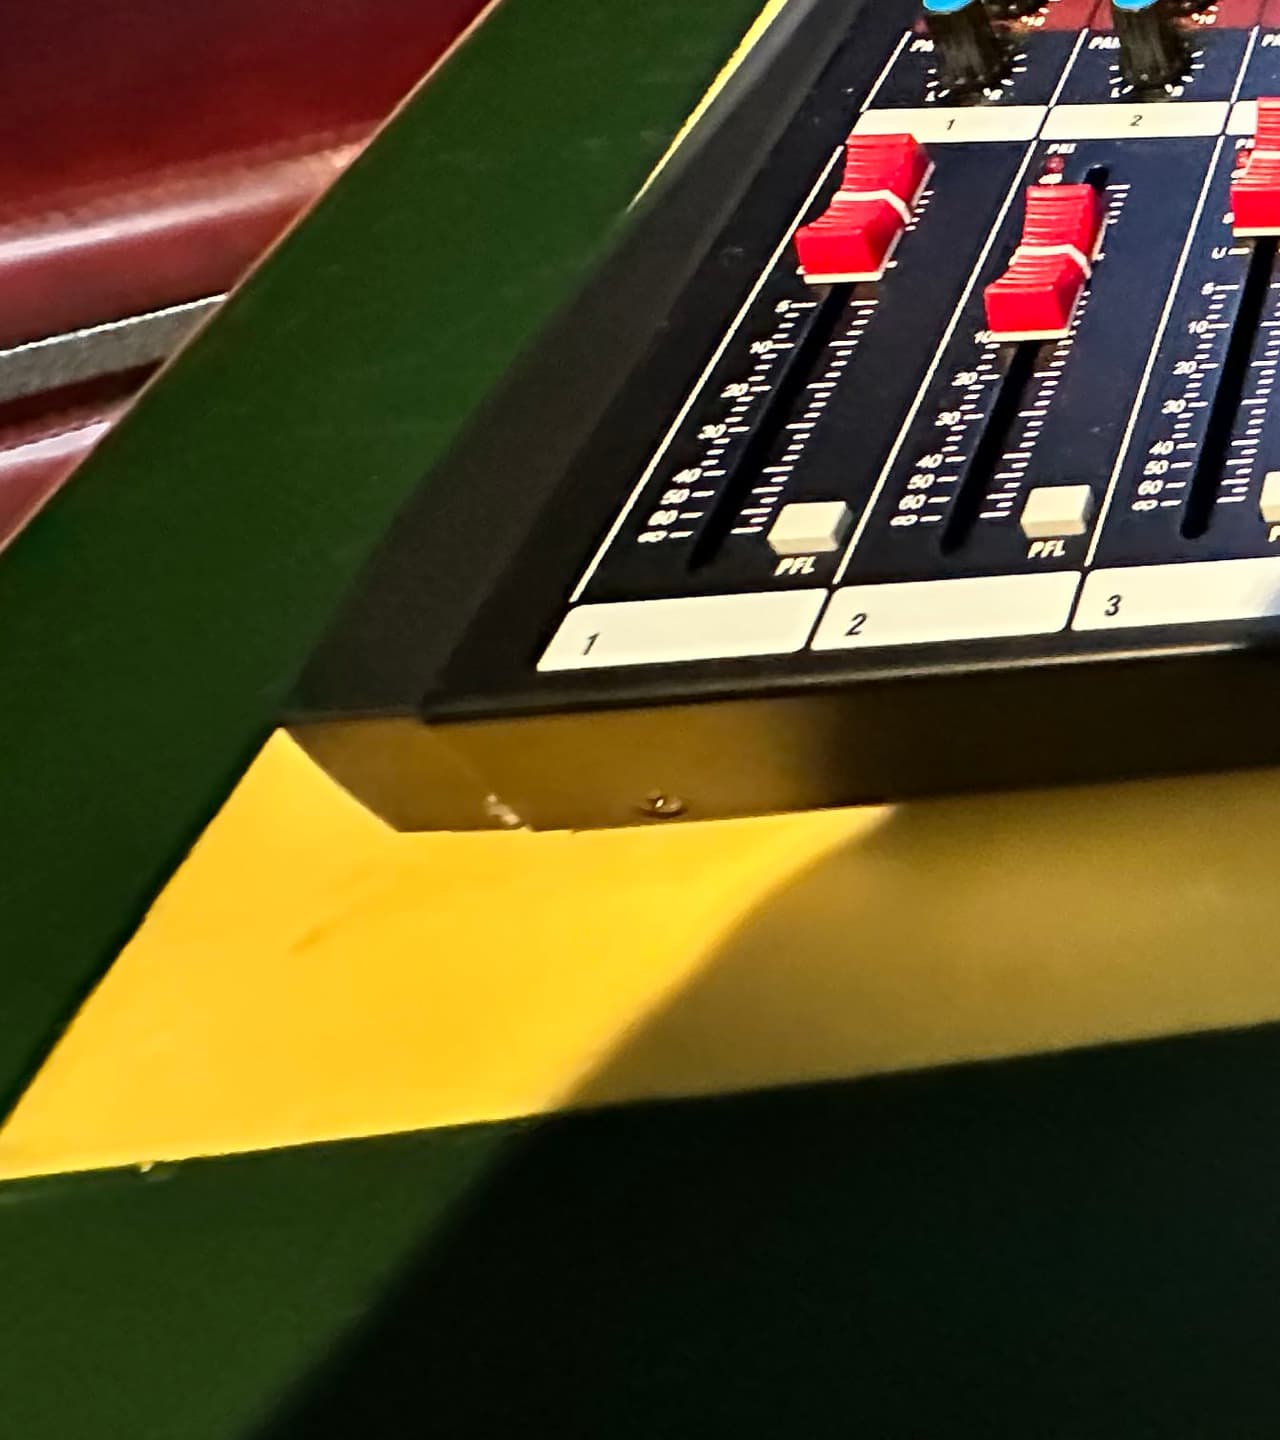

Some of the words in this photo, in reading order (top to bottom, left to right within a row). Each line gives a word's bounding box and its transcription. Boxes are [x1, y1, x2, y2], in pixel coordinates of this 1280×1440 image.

[1129, 114, 1144, 127] 2
[1186, 319, 1208, 334] 10
[1172, 360, 1198, 376] 20
[951, 371, 979, 387] 20
[720, 382, 750, 398] 20
[1161, 398, 1187, 415] 30
[933, 410, 962, 427] 30
[697, 423, 728, 440] 30
[1148, 440, 1175, 456] 40
[915, 453, 944, 469] 40
[1143, 459, 1170, 475] 50
[906, 473, 936, 490] 50
[1136, 479, 1165, 496] 60
[897, 493, 928, 510] 60
[1026, 539, 1067, 560] PFL
[773, 557, 817, 577] PFL
[1104, 593, 1124, 617] 3
[845, 612, 868, 638] 2
[580, 632, 601, 656] 1
